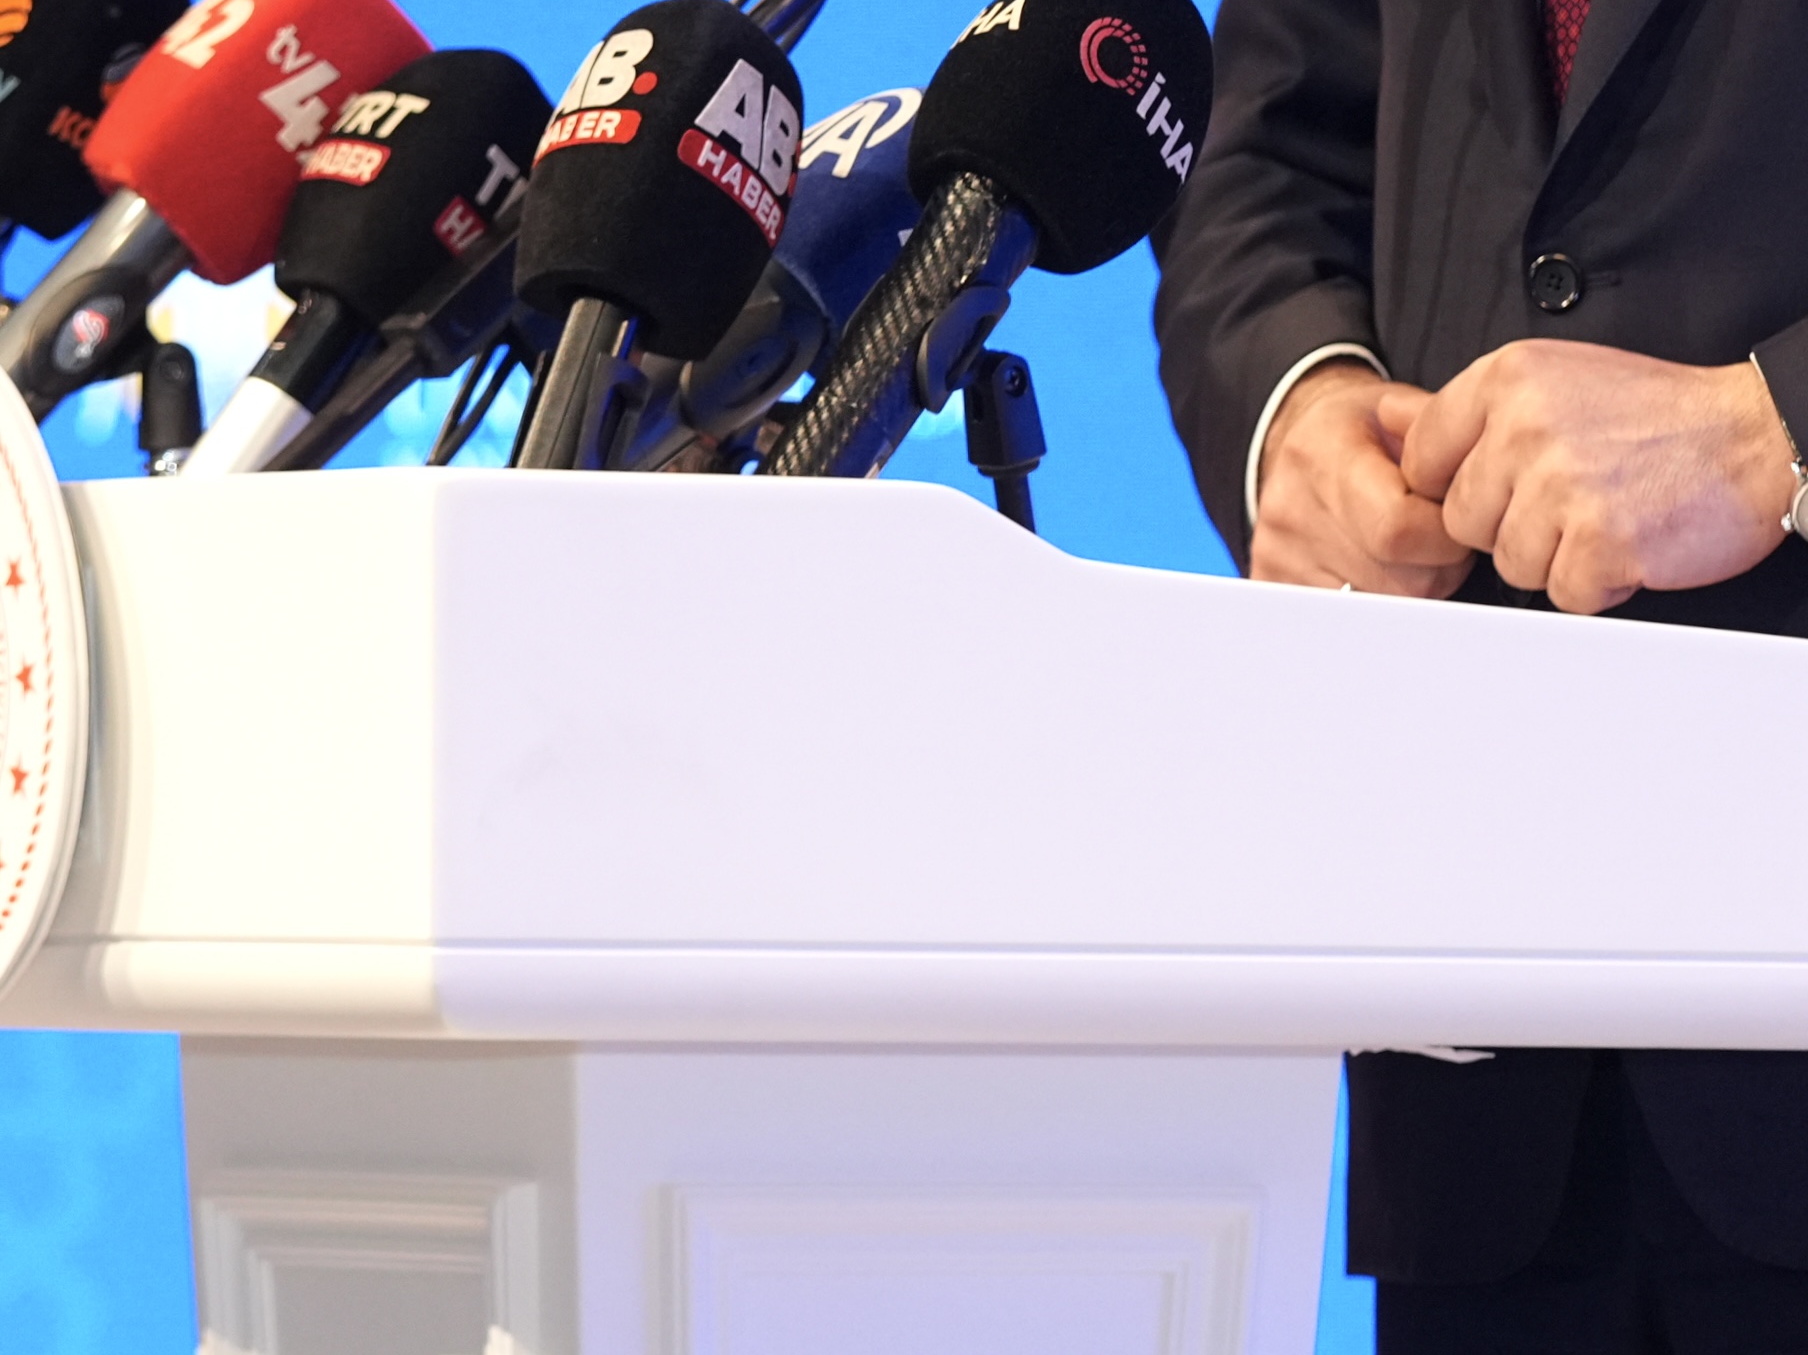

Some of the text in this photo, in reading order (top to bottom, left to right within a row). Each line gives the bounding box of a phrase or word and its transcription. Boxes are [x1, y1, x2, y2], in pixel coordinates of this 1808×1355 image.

[258, 59, 341, 164] 4
[1136, 72, 1194, 184] İHA
[697, 139, 783, 240] HABER
